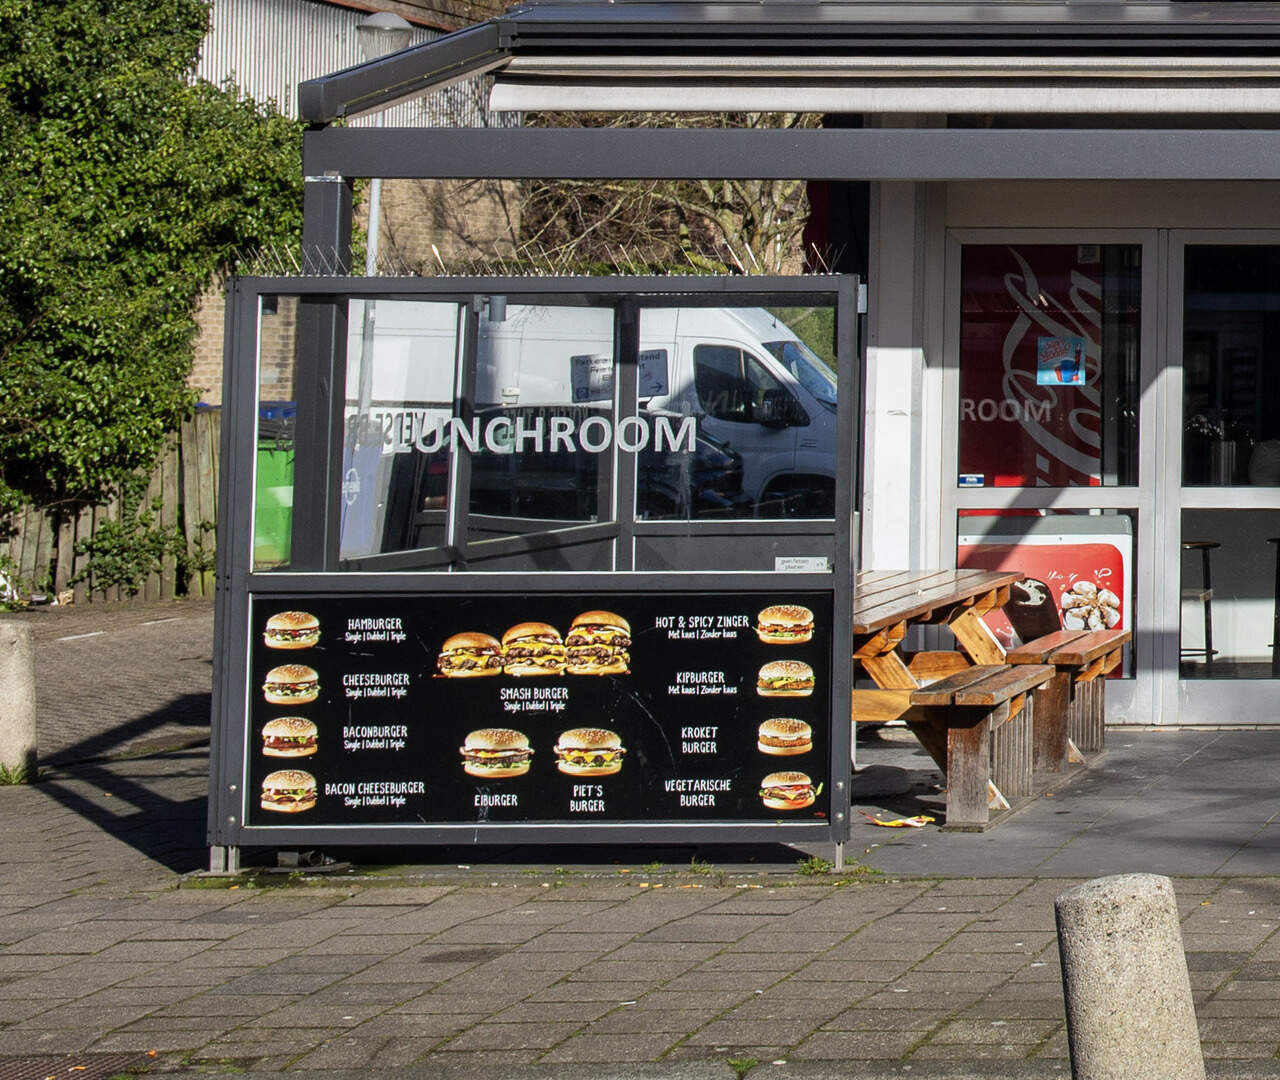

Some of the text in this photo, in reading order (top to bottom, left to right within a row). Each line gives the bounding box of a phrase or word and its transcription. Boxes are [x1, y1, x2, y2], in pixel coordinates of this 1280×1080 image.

[960, 398, 1051, 422] ROOM
[392, 416, 696, 454] LUNCHROOM
[348, 618, 402, 630] HAMBURGER
[656, 616, 749, 628] HOT & SPICY ZINGER
[345, 631, 407, 644] Single Dubbel Triple
[668, 630, 737, 639] Met kaas Zonder kaas
[343, 674, 410, 686] CHEESEBURGER
[676, 672, 725, 683] KIPBURGER
[345, 687, 407, 700] Single Dubbel Triple
[500, 688, 568, 700] SMASH BURGER
[668, 685, 737, 694] Met kaas Zonder kaas
[504, 701, 565, 714] Single Dubbel Triple
[343, 726, 408, 738] BACONBURGER
[681, 726, 718, 739] KROKET
[344, 739, 405, 752] Single Dubbel Triple
[682, 741, 717, 754] BURGER
[325, 782, 425, 795] BACON CHEESEBURGER
[573, 785, 603, 797] PIET'S
[665, 779, 731, 792] VEGETARISCHE
[344, 796, 406, 809] Single Dubbel Triple
[474, 794, 518, 807] EIBURGER
[570, 800, 605, 812] BURGER
[680, 794, 716, 807] BURGER
